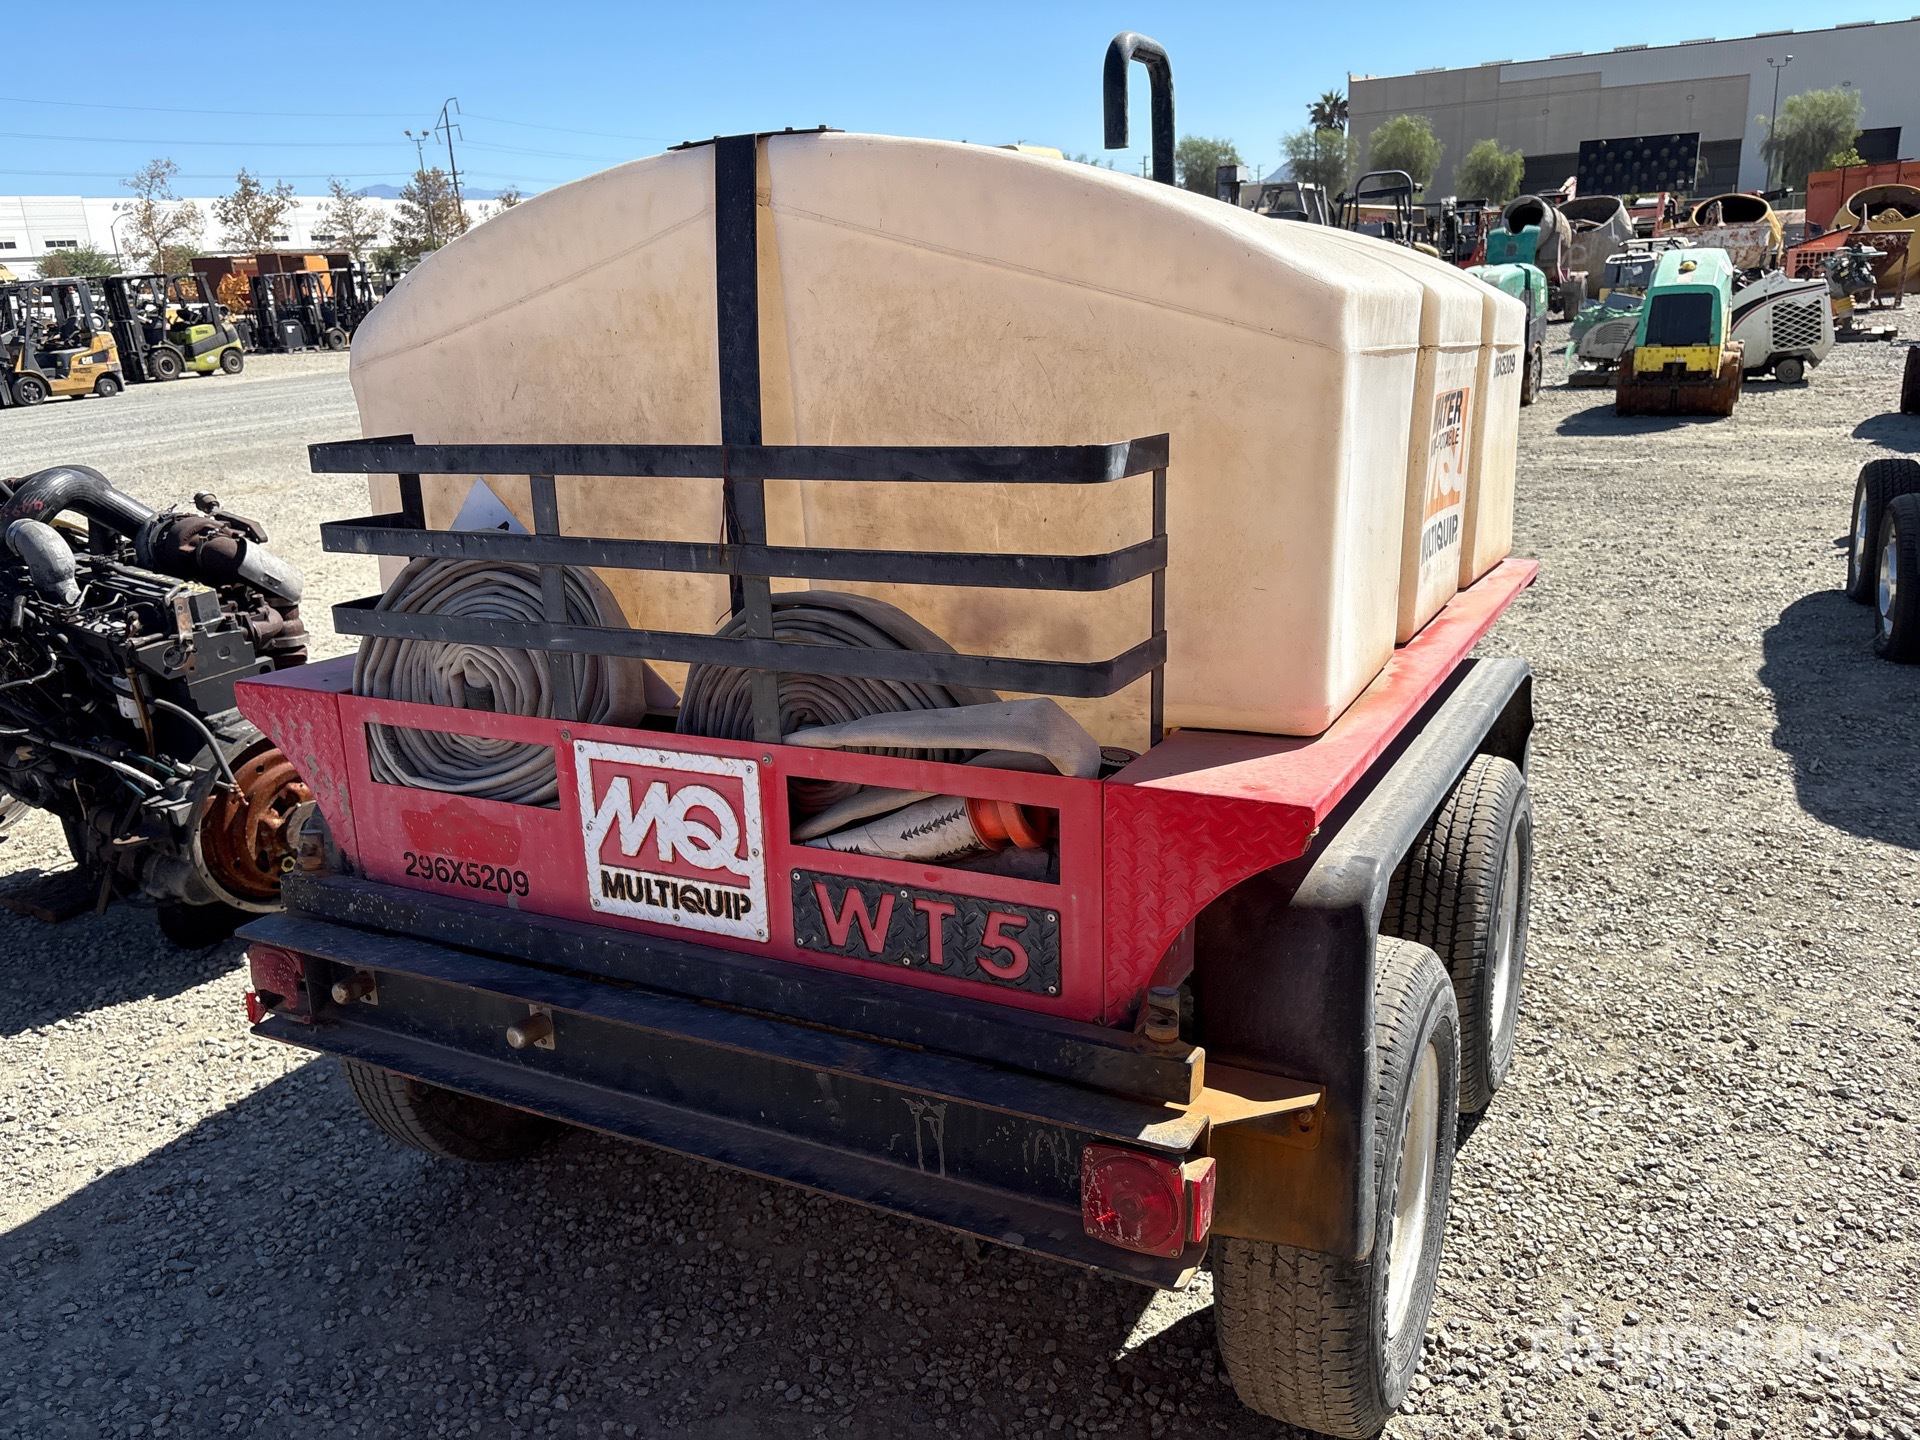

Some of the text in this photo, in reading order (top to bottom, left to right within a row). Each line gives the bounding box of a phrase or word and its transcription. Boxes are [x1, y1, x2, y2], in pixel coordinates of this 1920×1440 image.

[1494, 354, 1515, 378] 6X5209
[1430, 428, 1460, 458] N-POTABLE
[596, 776, 748, 874] MQ
[403, 852, 530, 897] 296X5209
[601, 870, 752, 921] MULTIQUIP
